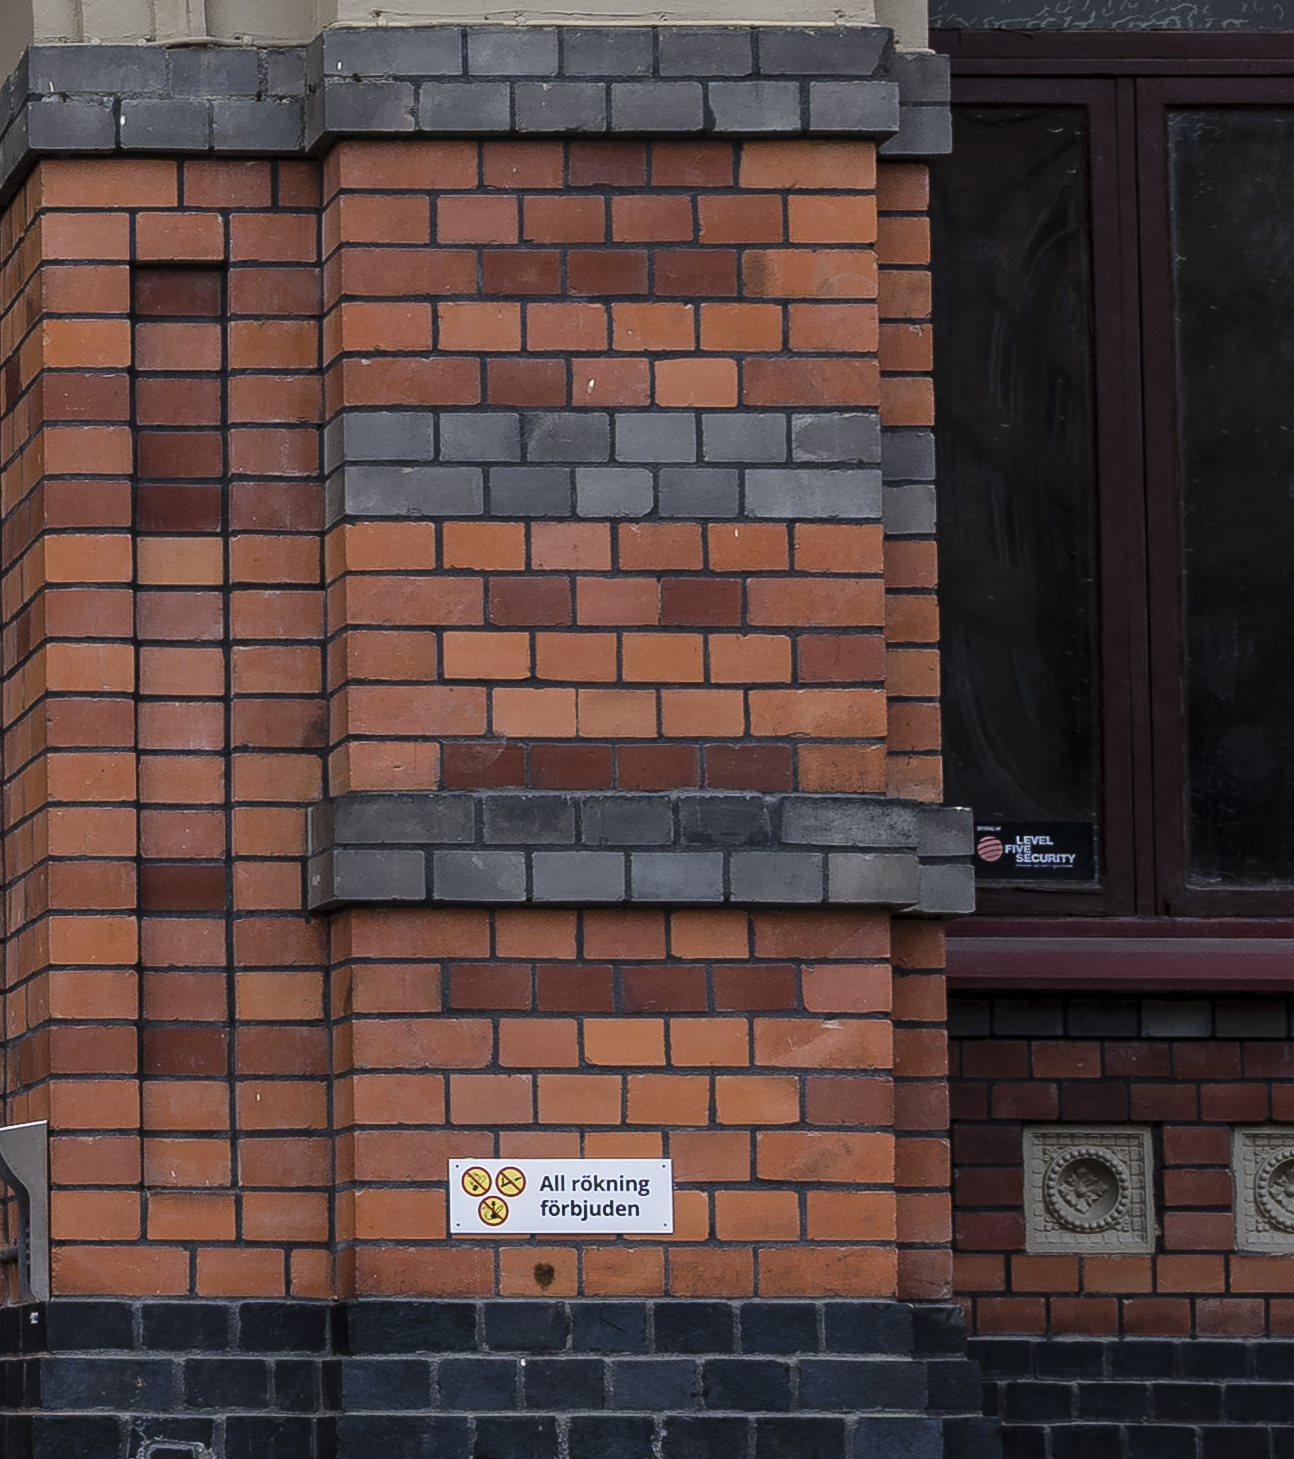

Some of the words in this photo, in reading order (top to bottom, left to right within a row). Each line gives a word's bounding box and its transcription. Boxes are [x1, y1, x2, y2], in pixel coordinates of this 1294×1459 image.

[1016, 836, 1054, 846] LEVEL
[1004, 844, 1032, 854] FIVE
[1016, 854, 1076, 863] SECURITY
[539, 1175, 565, 1192] All
[572, 1174, 650, 1196] rökning
[540, 1199, 640, 1221] förbjuden
